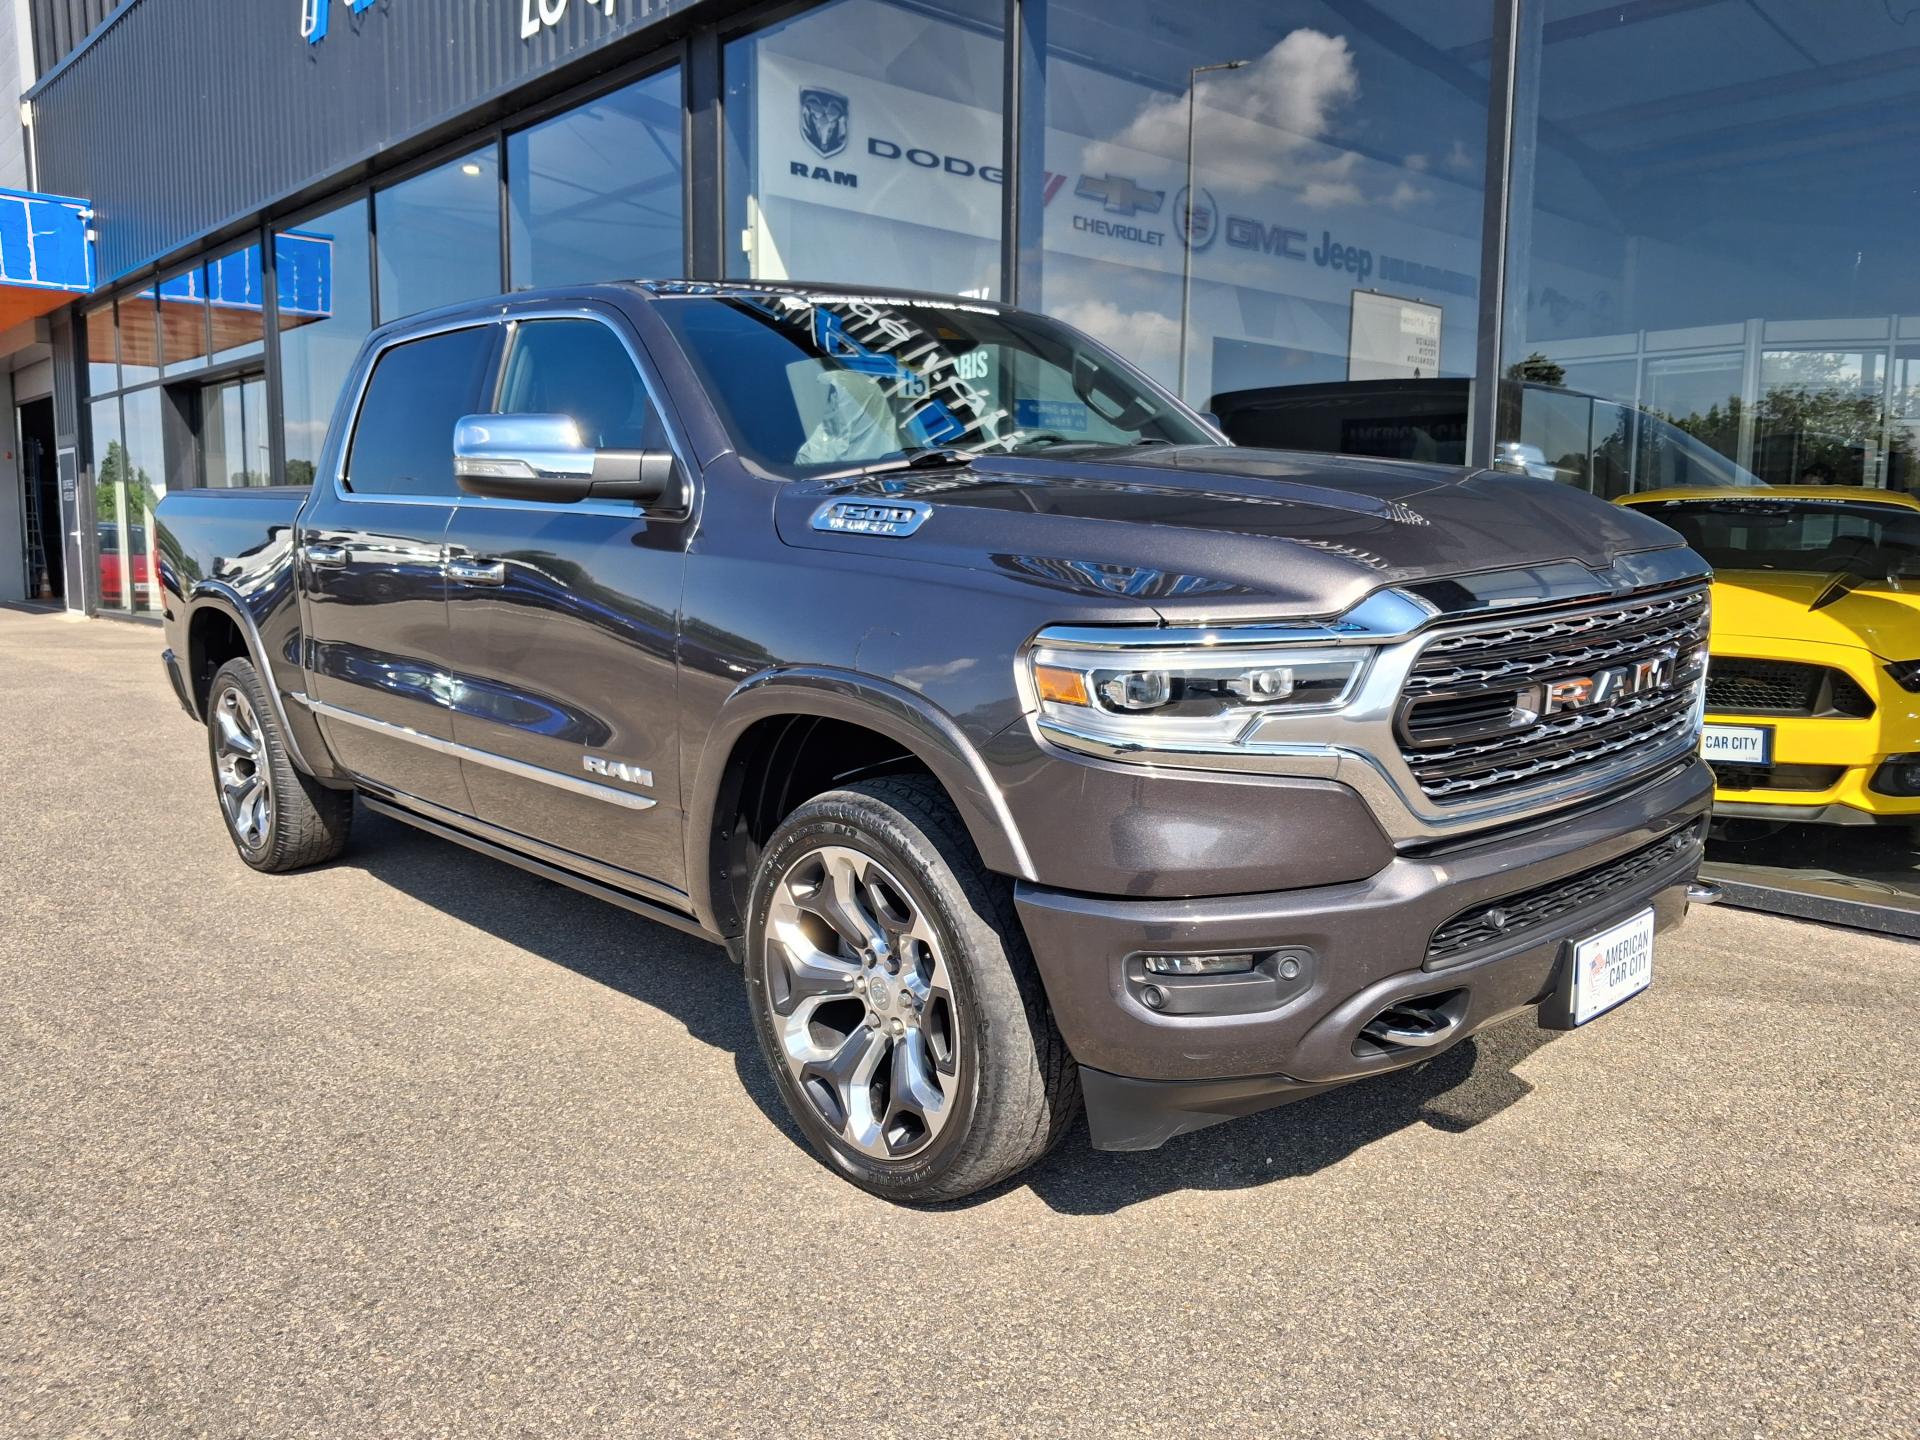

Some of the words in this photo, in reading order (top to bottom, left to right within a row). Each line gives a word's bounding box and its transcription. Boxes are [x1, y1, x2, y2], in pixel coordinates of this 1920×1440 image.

[790, 161, 857, 188] RAM
[868, 138, 1003, 184] DODG
[1072, 215, 1165, 247] CHEVROLET
[1225, 213, 1308, 261] GMC
[1313, 230, 1373, 282] Jeep
[829, 503, 915, 524] 1500
[1543, 648, 1675, 715] RAM
[1705, 735, 1729, 749] CAR
[1731, 736, 1759, 752] CITY
[583, 755, 654, 787] RAM
[1605, 929, 1648, 968] AMERICAN
[1609, 965, 1627, 987] CAR
[1629, 951, 1648, 976] CITY
